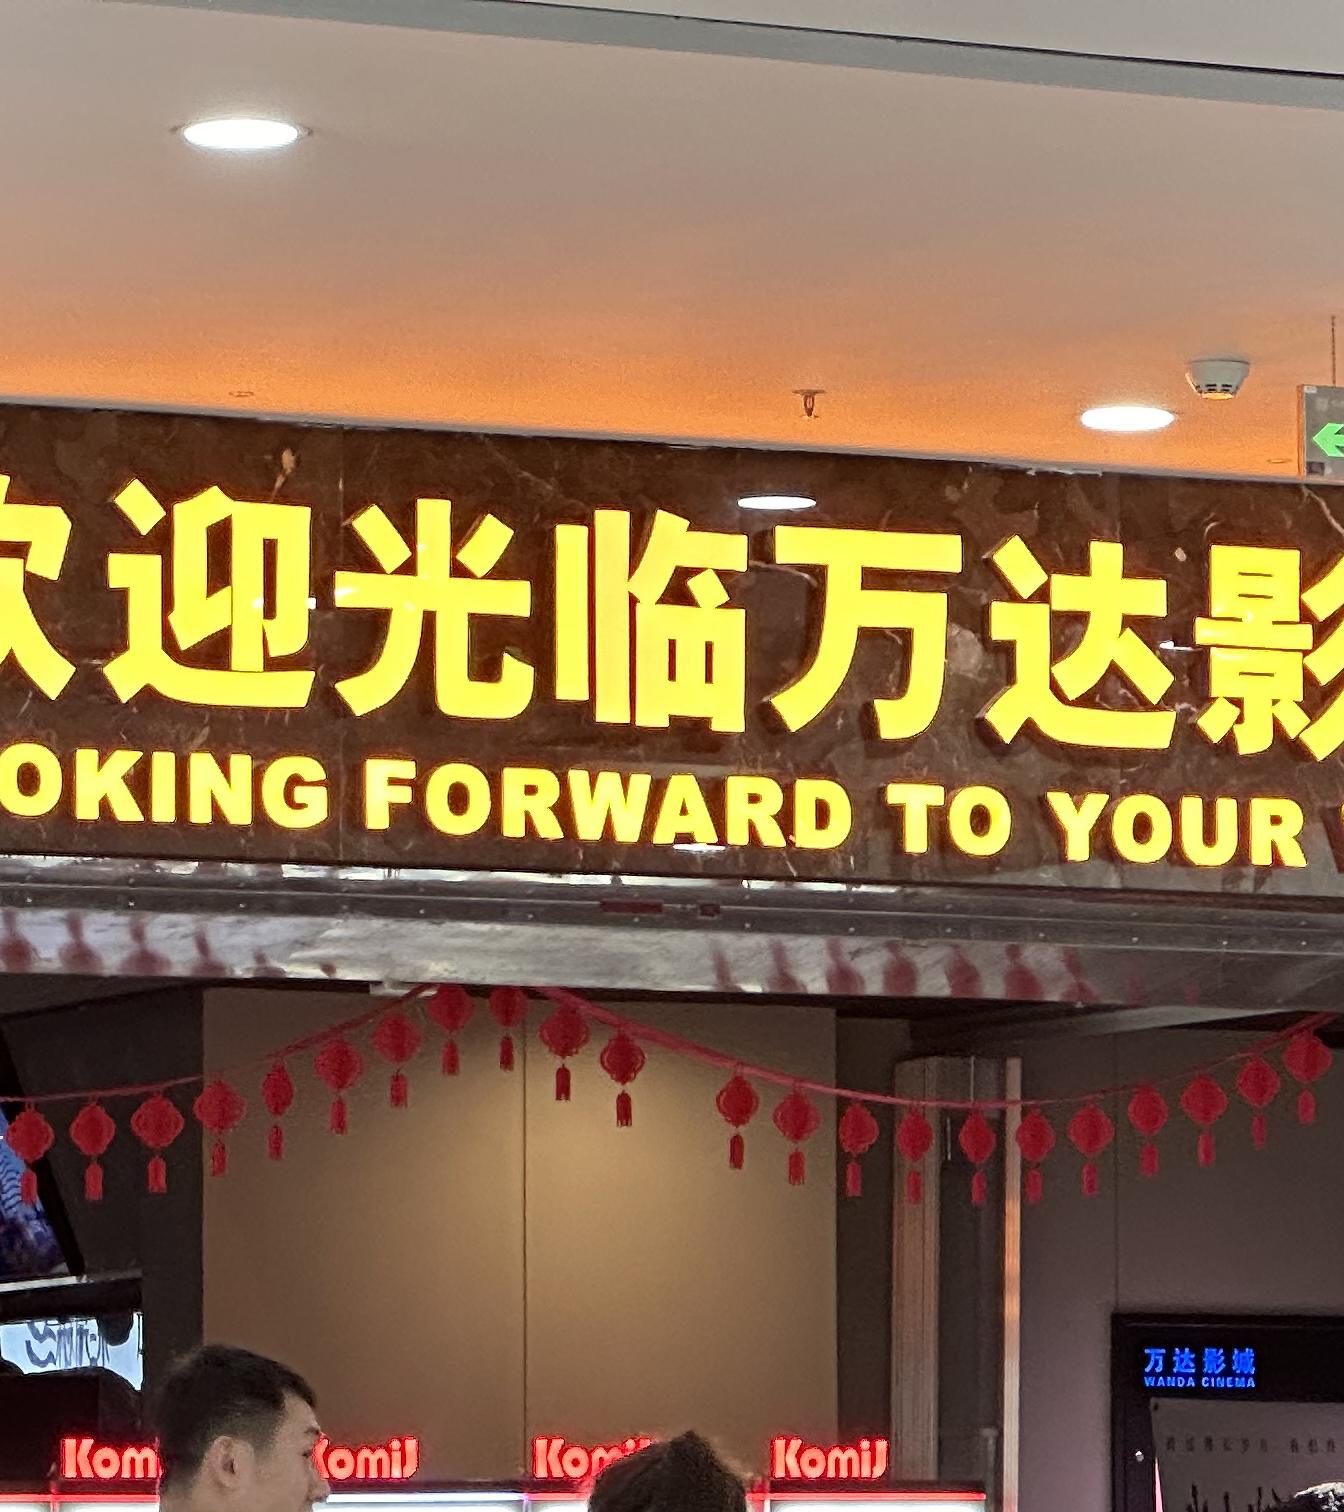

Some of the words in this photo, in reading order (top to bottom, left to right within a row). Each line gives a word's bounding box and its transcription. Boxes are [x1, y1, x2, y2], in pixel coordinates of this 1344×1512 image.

[364, 758, 852, 850] FORWARD
[886, 783, 1011, 856] TO
[1046, 791, 1307, 868] YOUR
[1144, 1347, 1255, 1375] 万达影城
[1144, 1376, 1196, 1388] WANDA
[1201, 1376, 1256, 1388] CINEMA
[771, 1436, 889, 1479] KomiJ
